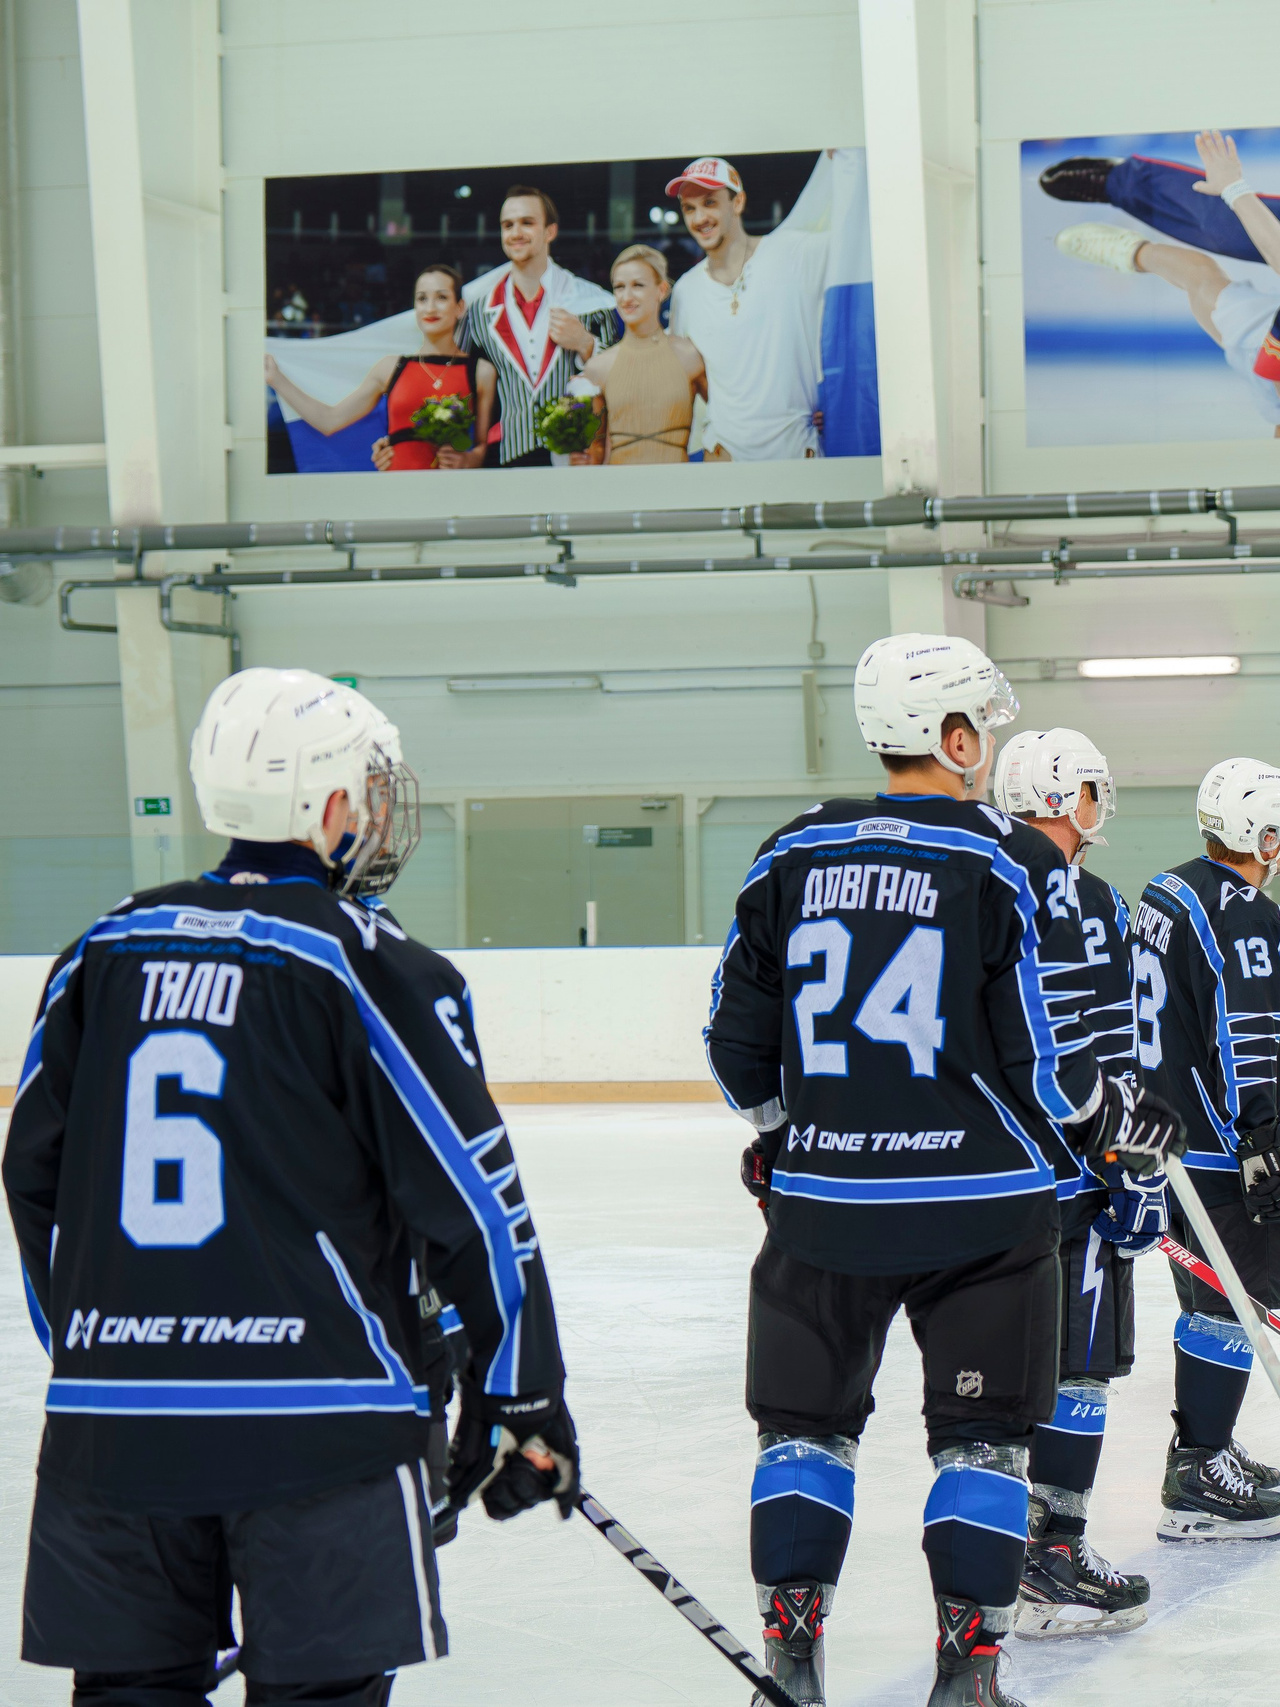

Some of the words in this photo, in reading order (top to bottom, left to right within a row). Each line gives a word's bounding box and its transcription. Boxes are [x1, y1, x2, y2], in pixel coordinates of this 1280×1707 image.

[802, 864, 938, 918] ДОВГАЛЬ
[1233, 936, 1273, 979] 13
[139, 960, 244, 1027] ТЯЛО
[786, 917, 946, 1080] 24
[120, 1028, 227, 1249] 6
[818, 1131, 867, 1151] ONE
[870, 1130, 965, 1151] TIMER
[1160, 1238, 1199, 1268] FIRE
[98, 1316, 177, 1344] ONE
[180, 1316, 306, 1344] TIMER
[1203, 1491, 1234, 1506] BAUER
[1078, 1582, 1105, 1595] BAUER
